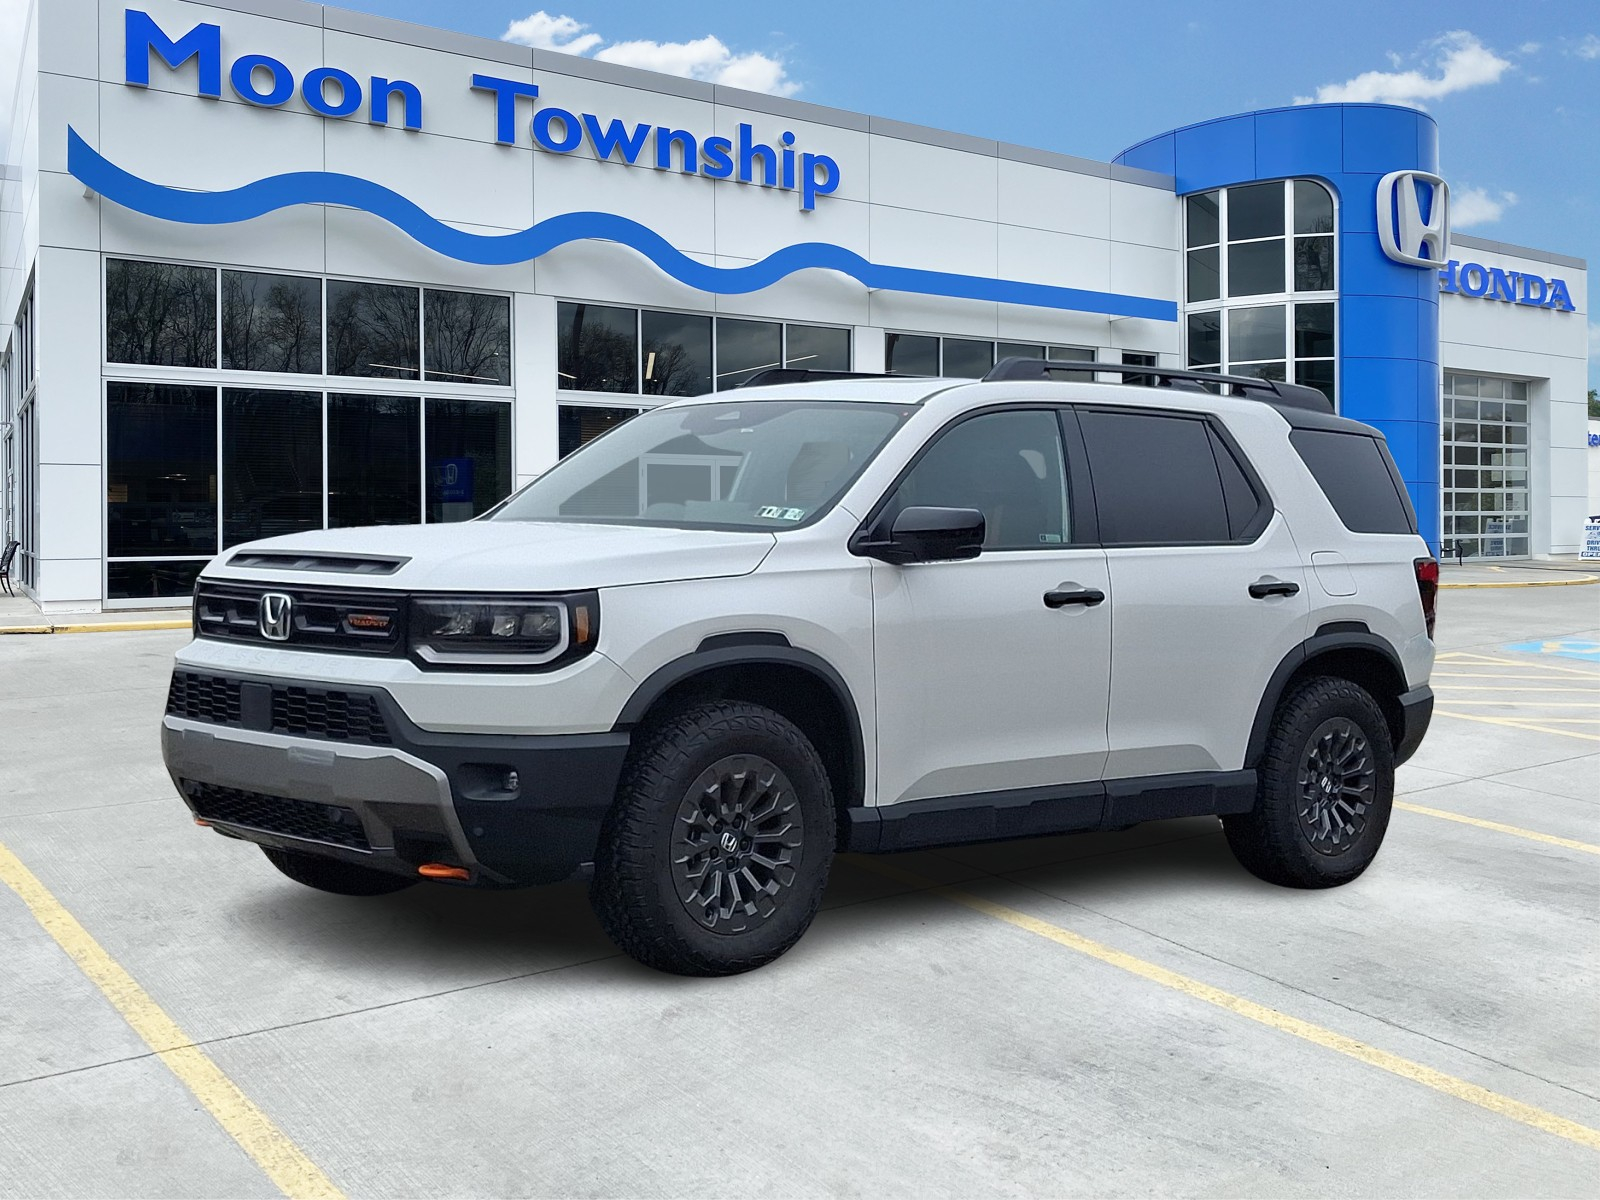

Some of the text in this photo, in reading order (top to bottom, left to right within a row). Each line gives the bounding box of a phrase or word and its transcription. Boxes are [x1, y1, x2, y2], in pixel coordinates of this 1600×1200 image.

[125, 9, 841, 211] Moon Township
[1439, 260, 1577, 311] HONDA
